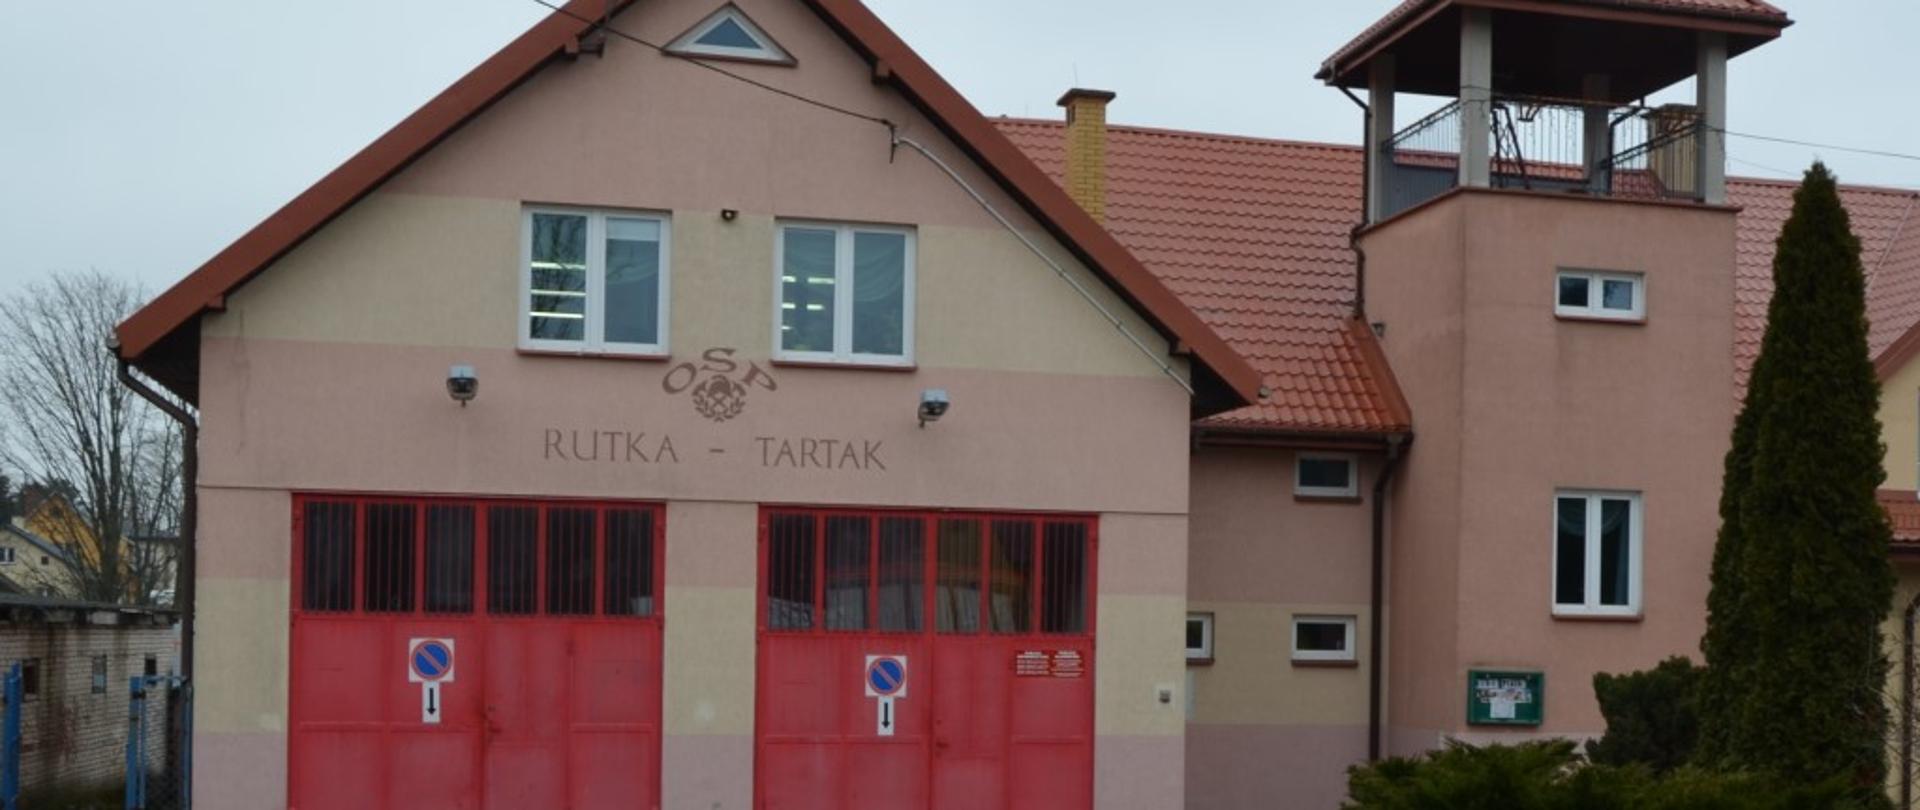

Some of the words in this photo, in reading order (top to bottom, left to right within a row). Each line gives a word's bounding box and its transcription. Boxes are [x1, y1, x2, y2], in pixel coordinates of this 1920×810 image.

[661, 347, 778, 395] OSP
[543, 428, 679, 464] RUTKA
[755, 436, 887, 471] TARTAK
